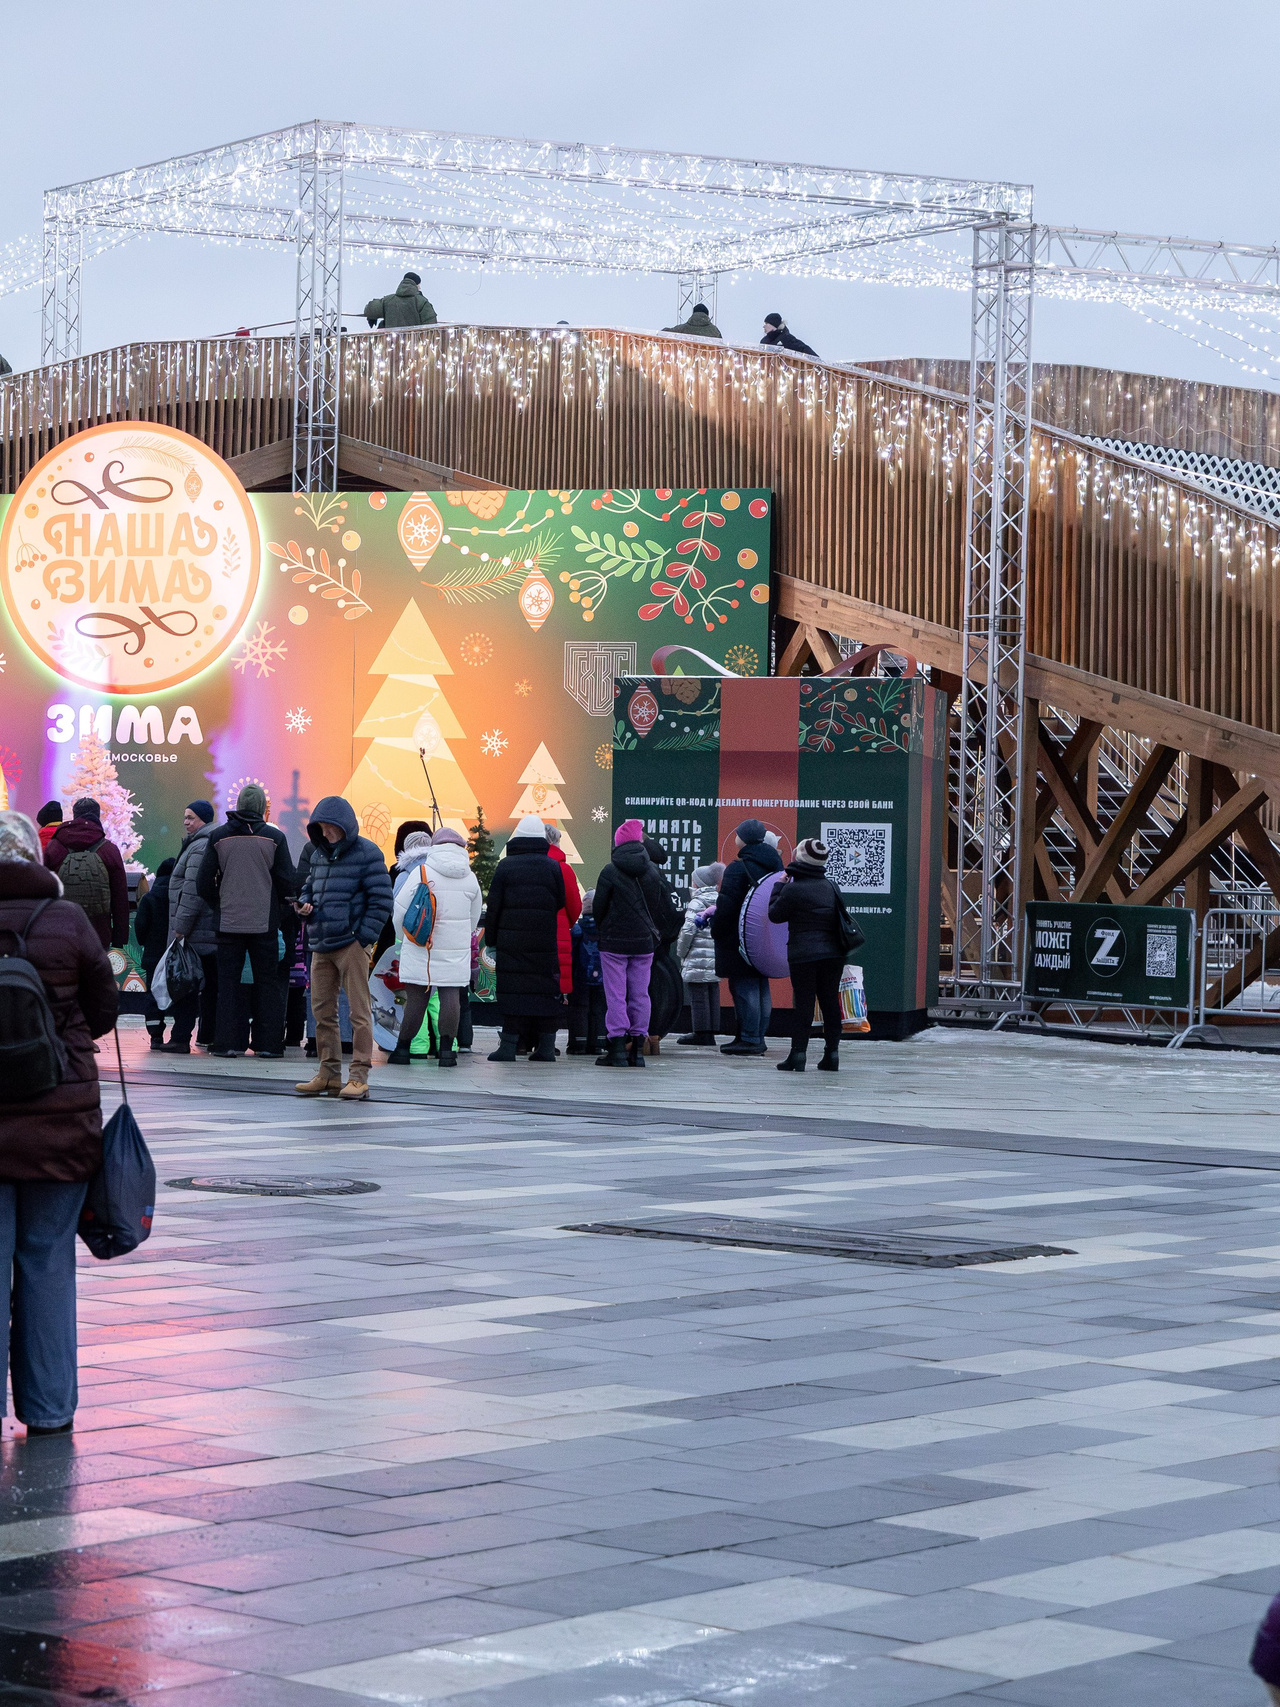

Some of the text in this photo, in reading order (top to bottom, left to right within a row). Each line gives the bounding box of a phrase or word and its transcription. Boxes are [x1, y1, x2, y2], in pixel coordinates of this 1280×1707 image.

[43, 512, 218, 557] НАША
[42, 559, 213, 604] ЗИМА
[46, 703, 204, 745] ЗИМА
[624, 796, 894, 809] СКАНИРУЙТЕ QR-КОД И ДЕЛАЙТЕ ПОЖЕРТВОВАНИЕ ЧЕРЕЗ СВОЙ БАНК
[624, 819, 702, 834] ИНЯТЬ
